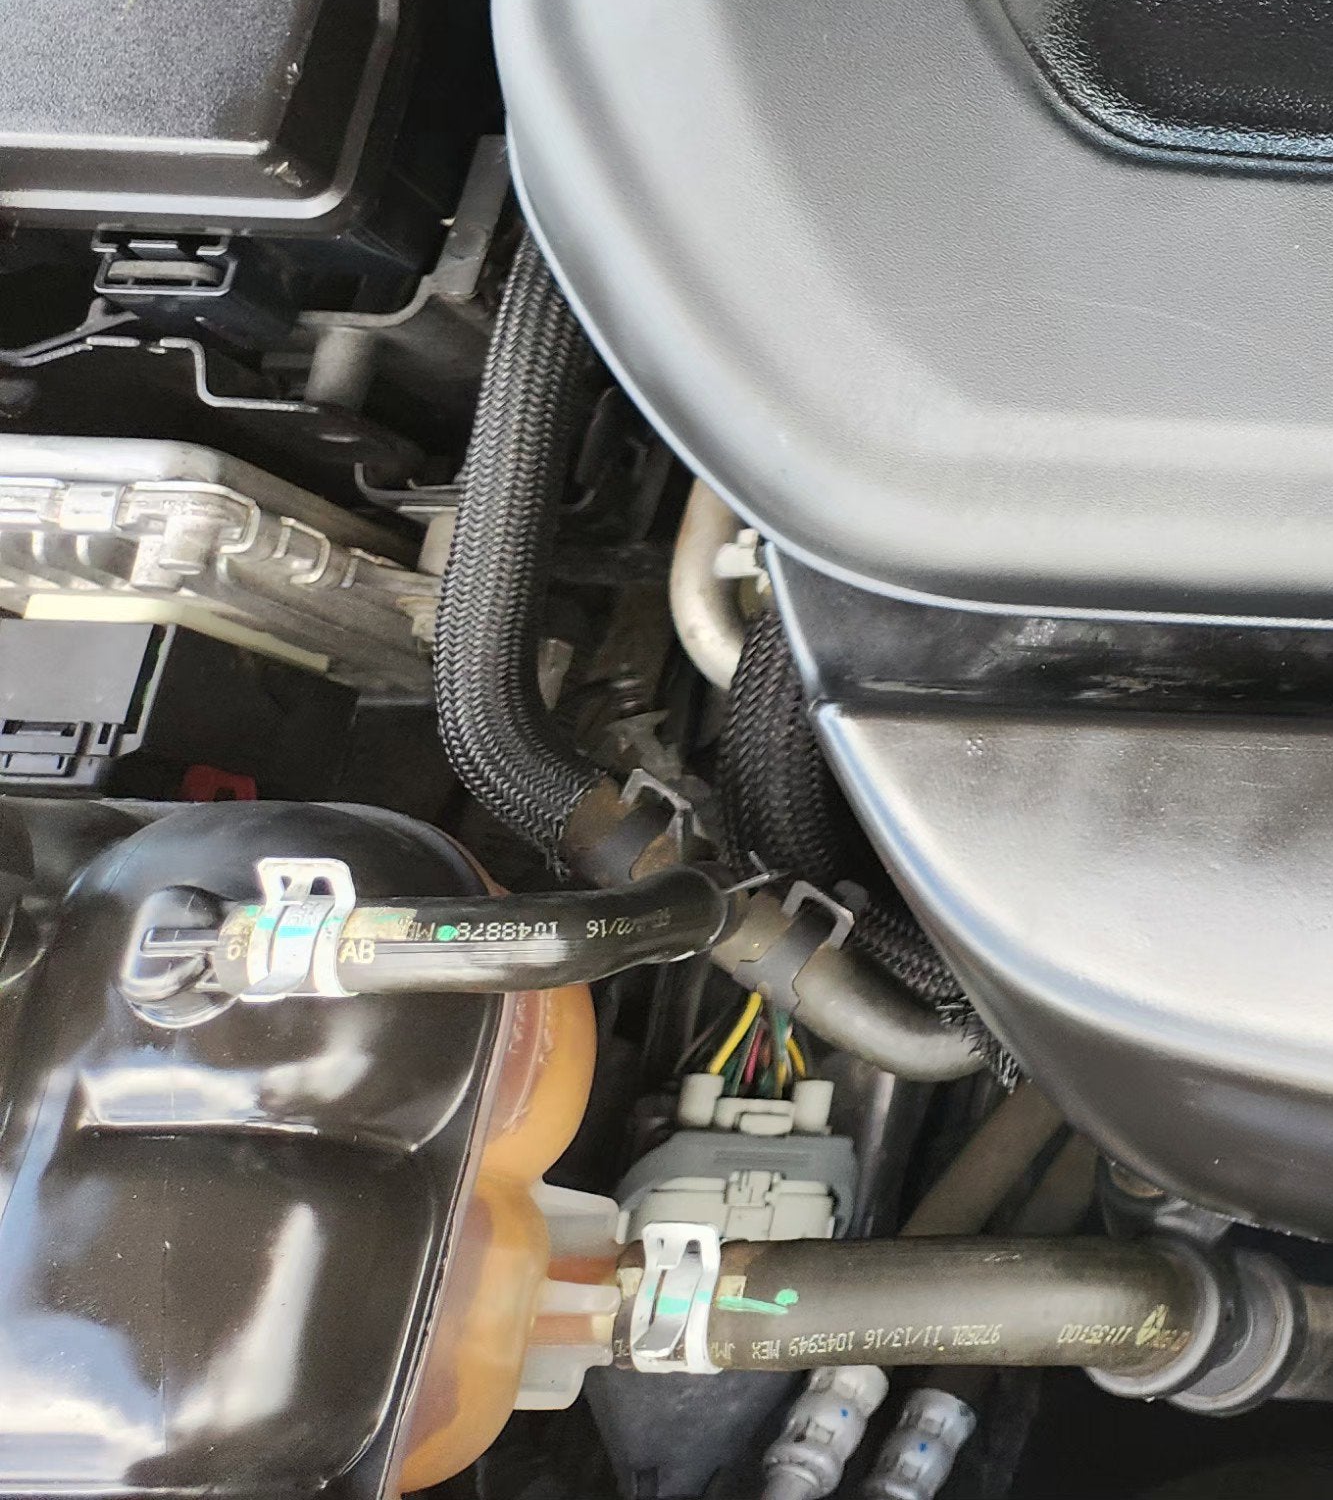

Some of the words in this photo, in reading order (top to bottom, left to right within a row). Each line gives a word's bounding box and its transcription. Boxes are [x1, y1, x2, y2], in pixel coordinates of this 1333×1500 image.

[752, 1338, 780, 1360] MEX
[788, 1330, 856, 1357] 1045949
[863, 1323, 943, 1349] 11/13/16
